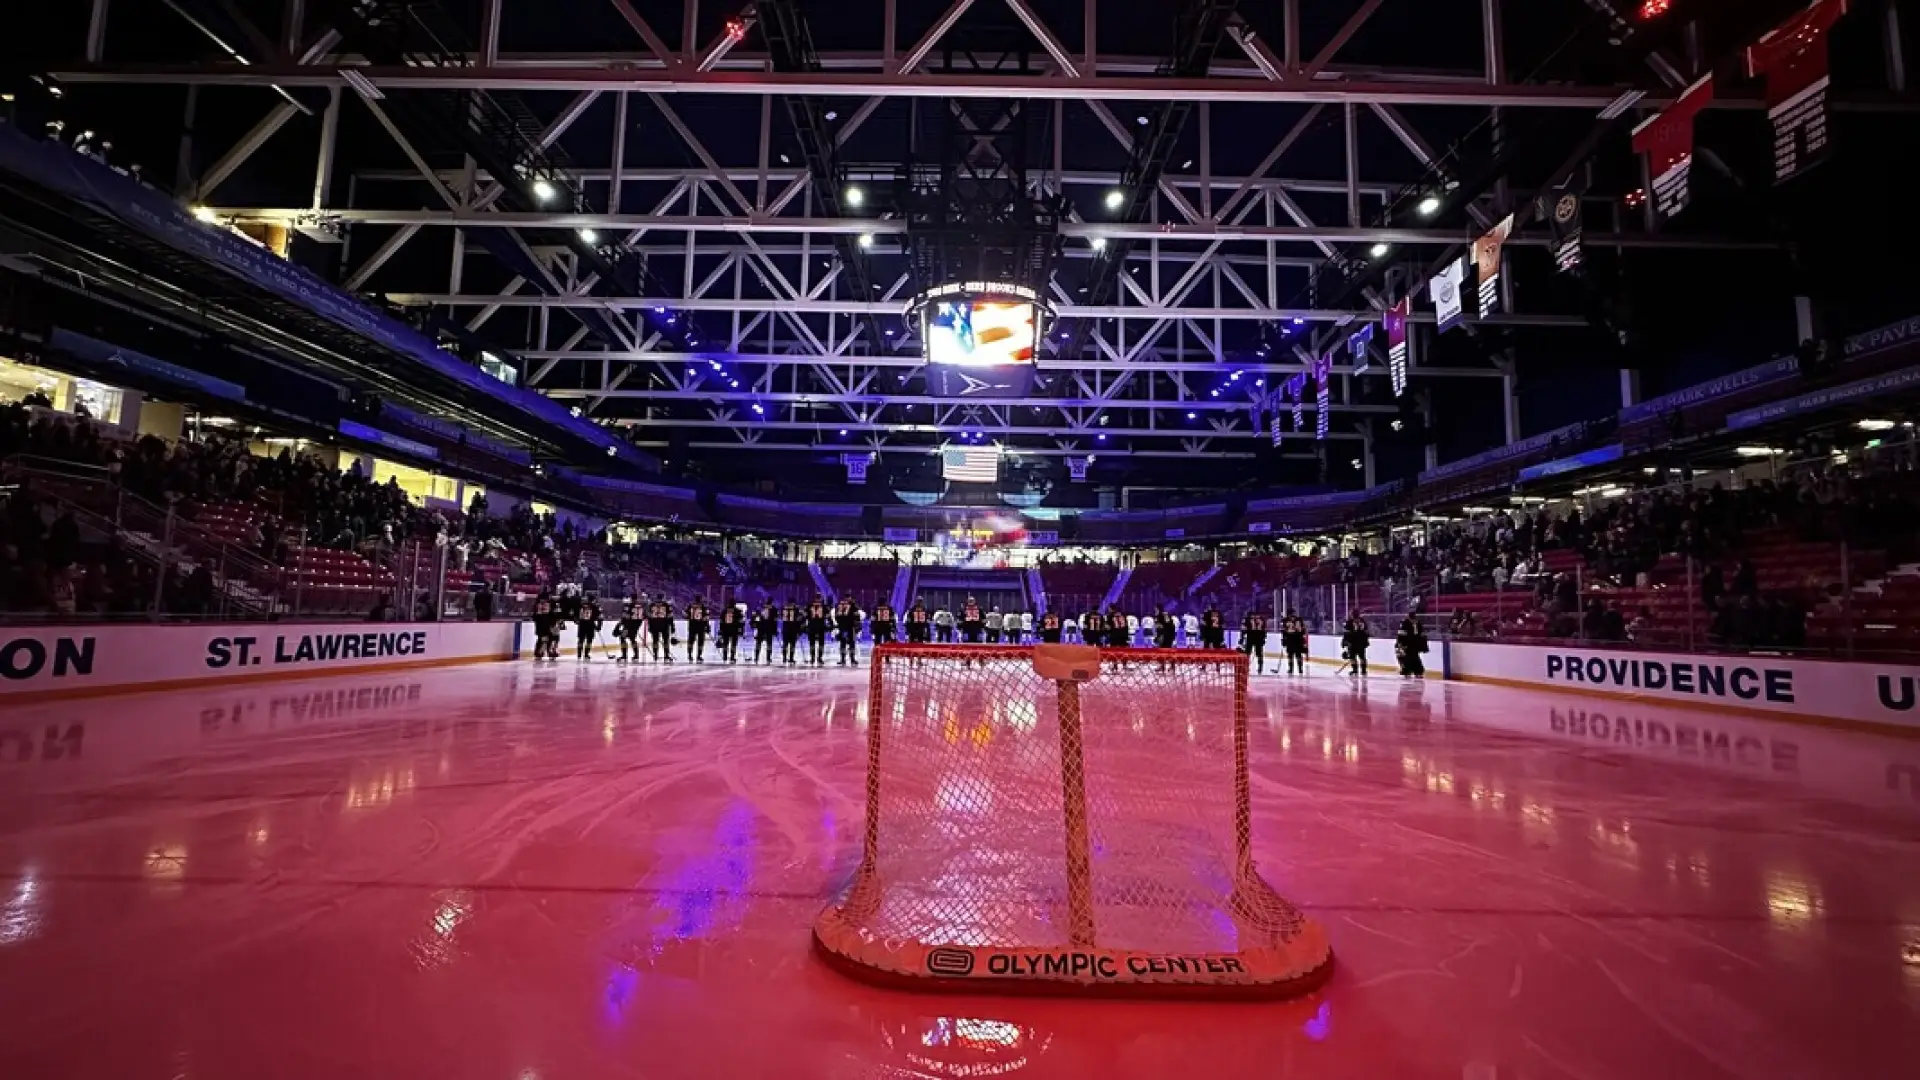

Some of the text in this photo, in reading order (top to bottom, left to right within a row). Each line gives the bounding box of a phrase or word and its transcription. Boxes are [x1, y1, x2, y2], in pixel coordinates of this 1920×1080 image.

[1709, 373, 1760, 395] WELLS
[0, 637, 96, 679] ON
[206, 632, 426, 667] ST. LAWRENCE
[1547, 655, 1794, 703] PROVIDENCE
[987, 953, 1244, 977] OLYMPIC CENTER
